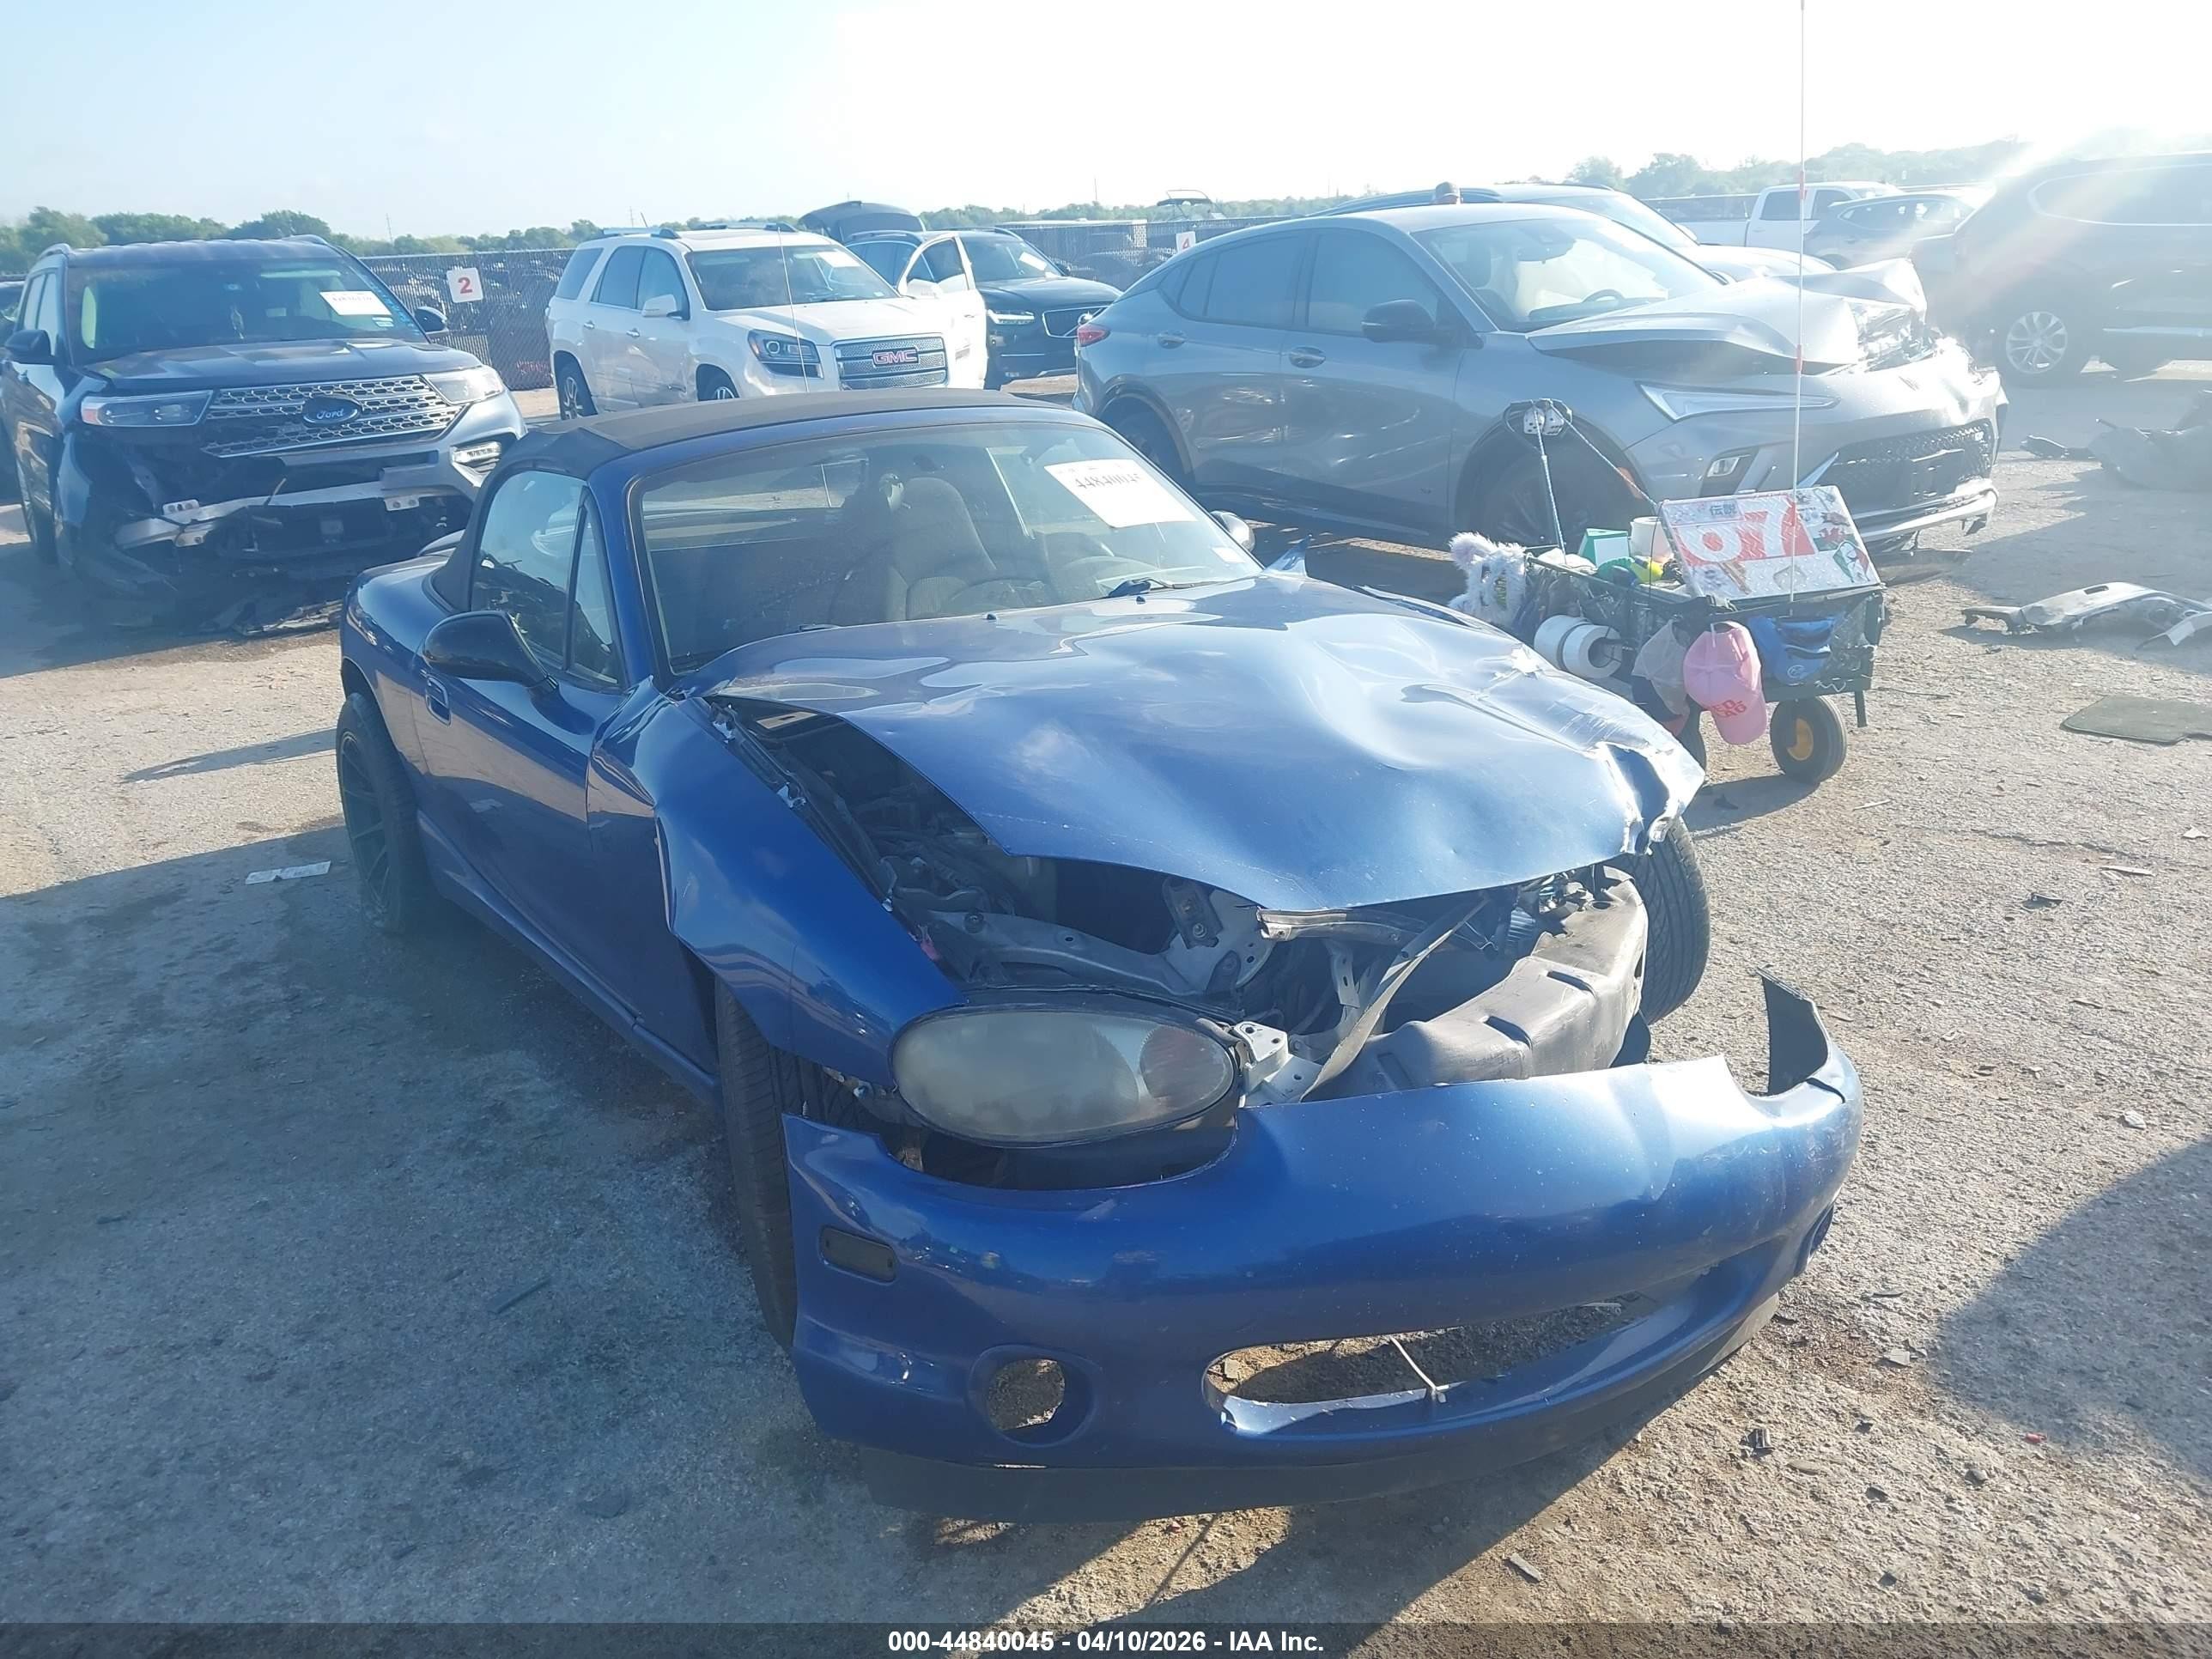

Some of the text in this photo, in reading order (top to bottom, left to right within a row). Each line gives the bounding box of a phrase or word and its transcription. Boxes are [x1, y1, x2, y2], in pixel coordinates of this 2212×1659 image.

[458, 276, 473, 294] 2
[873, 349, 917, 365] GMC
[316, 408, 344, 420] Ford
